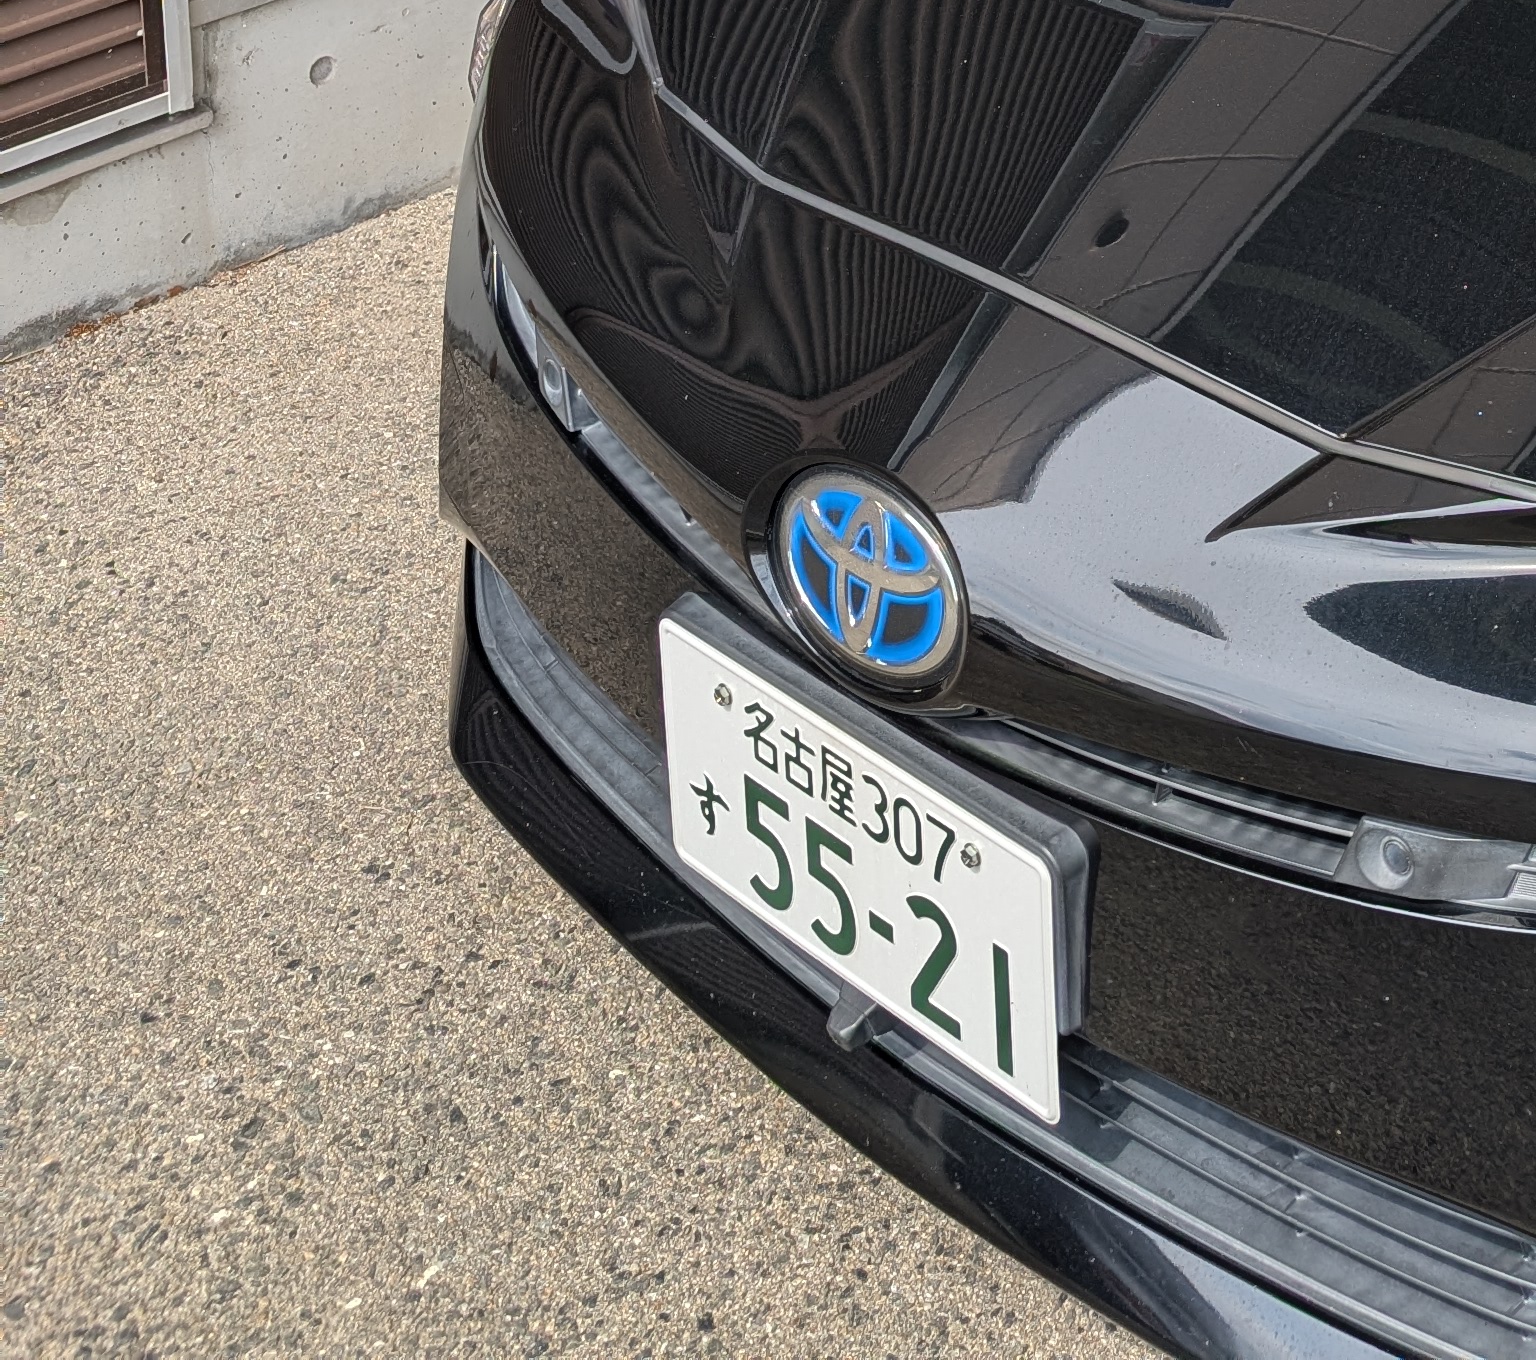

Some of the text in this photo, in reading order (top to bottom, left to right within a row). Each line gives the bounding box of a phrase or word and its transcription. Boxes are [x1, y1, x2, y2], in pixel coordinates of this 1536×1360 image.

[743, 700, 957, 883] 名古屋 307
[688, 771, 1016, 1079] す 55-21
